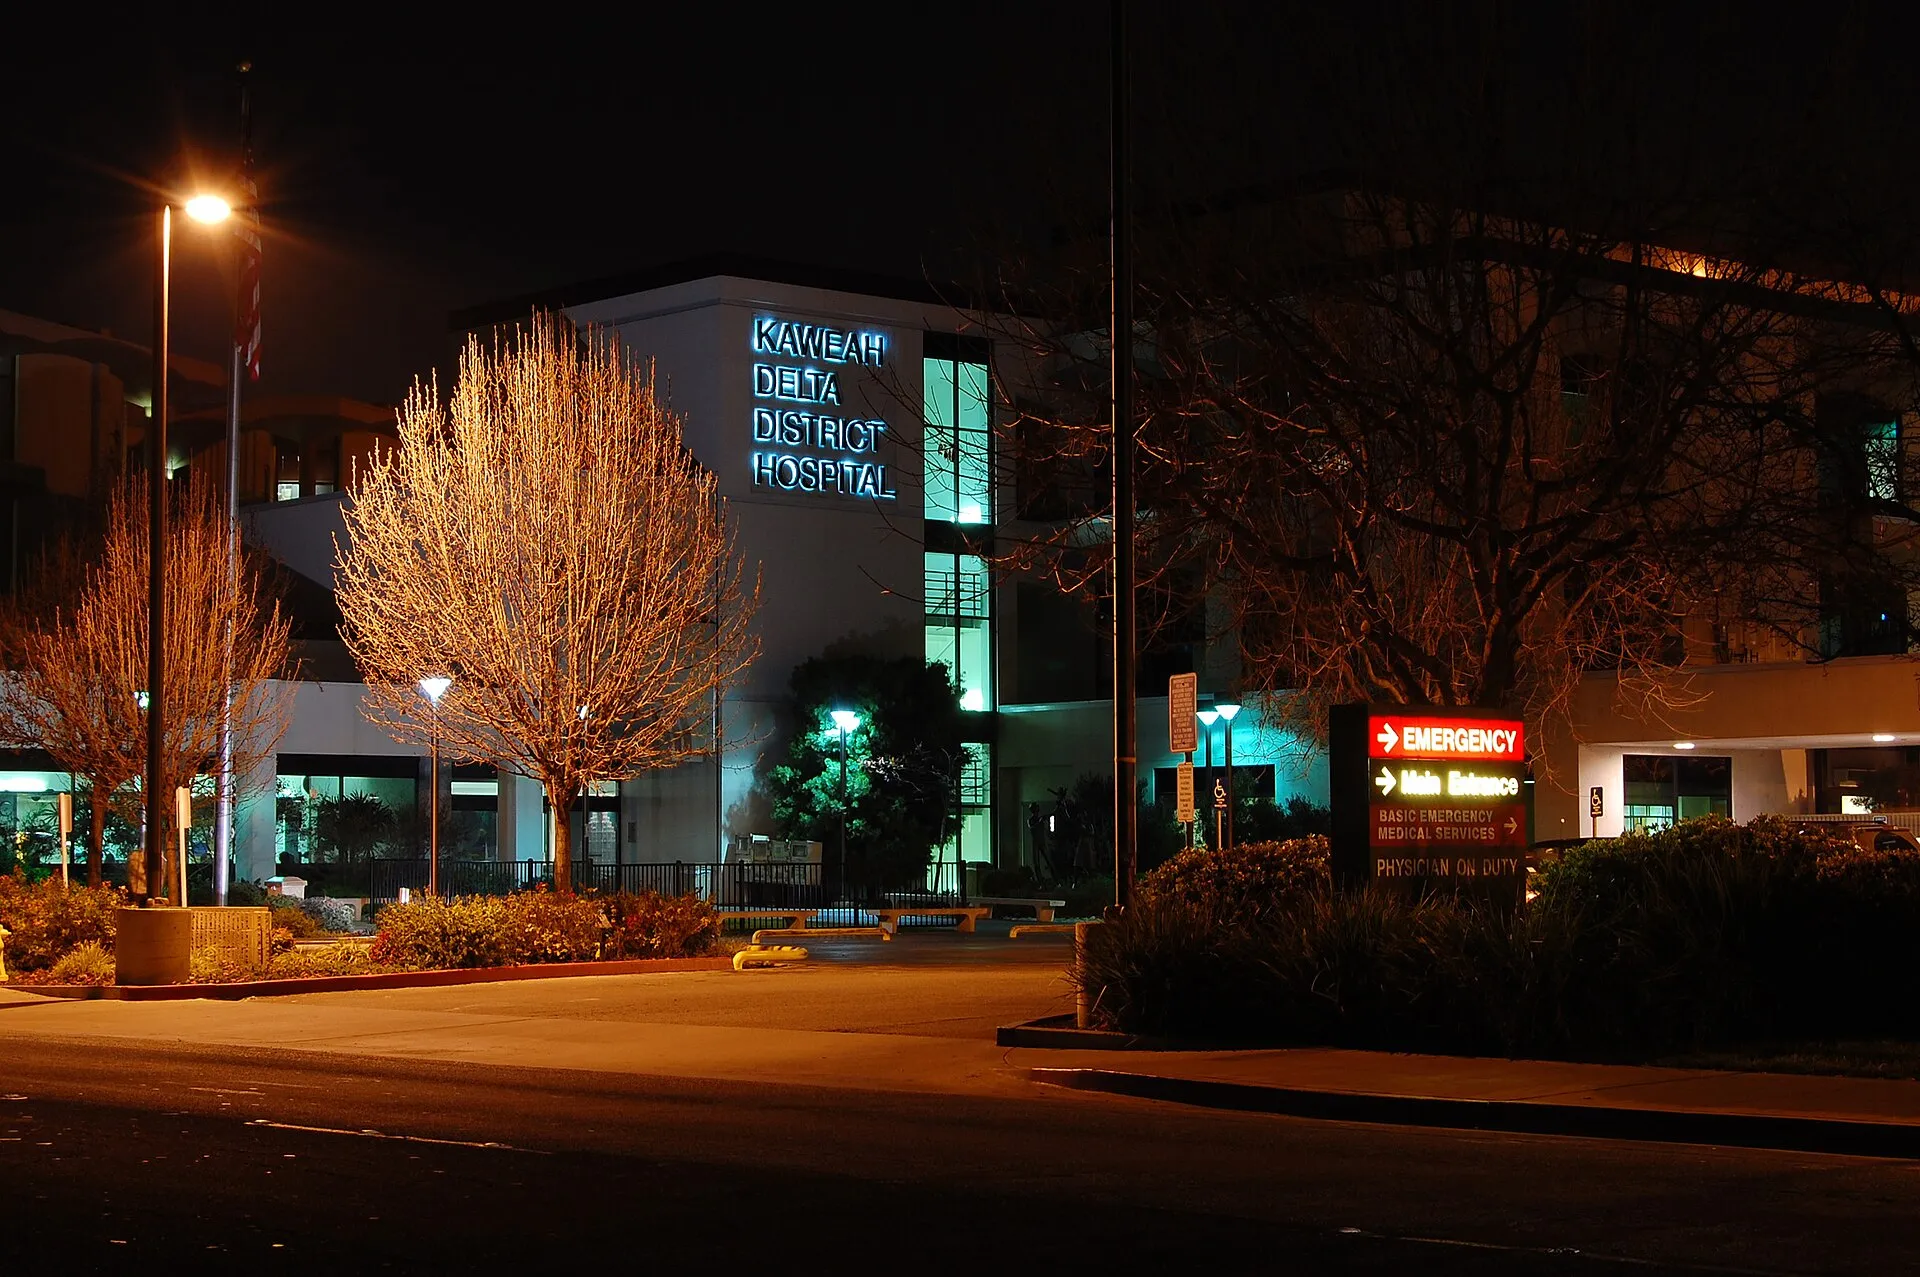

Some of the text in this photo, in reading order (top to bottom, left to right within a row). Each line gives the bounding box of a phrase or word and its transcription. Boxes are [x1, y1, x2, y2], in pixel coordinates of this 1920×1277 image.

[754, 319, 886, 367] KAWEAH
[754, 364, 843, 406] DELTA
[754, 408, 888, 453] DISTRICT
[754, 454, 896, 499] HOSPITAL
[1403, 727, 1517, 753] EMERGENCY
[1400, 769, 1519, 796] Main Entrance
[1379, 809, 1493, 823] BASIC EMERGENCY
[1378, 827, 1495, 840] MEDICAL SERVICES
[1377, 858, 1518, 877] PHYSICIAN ON DUTY
